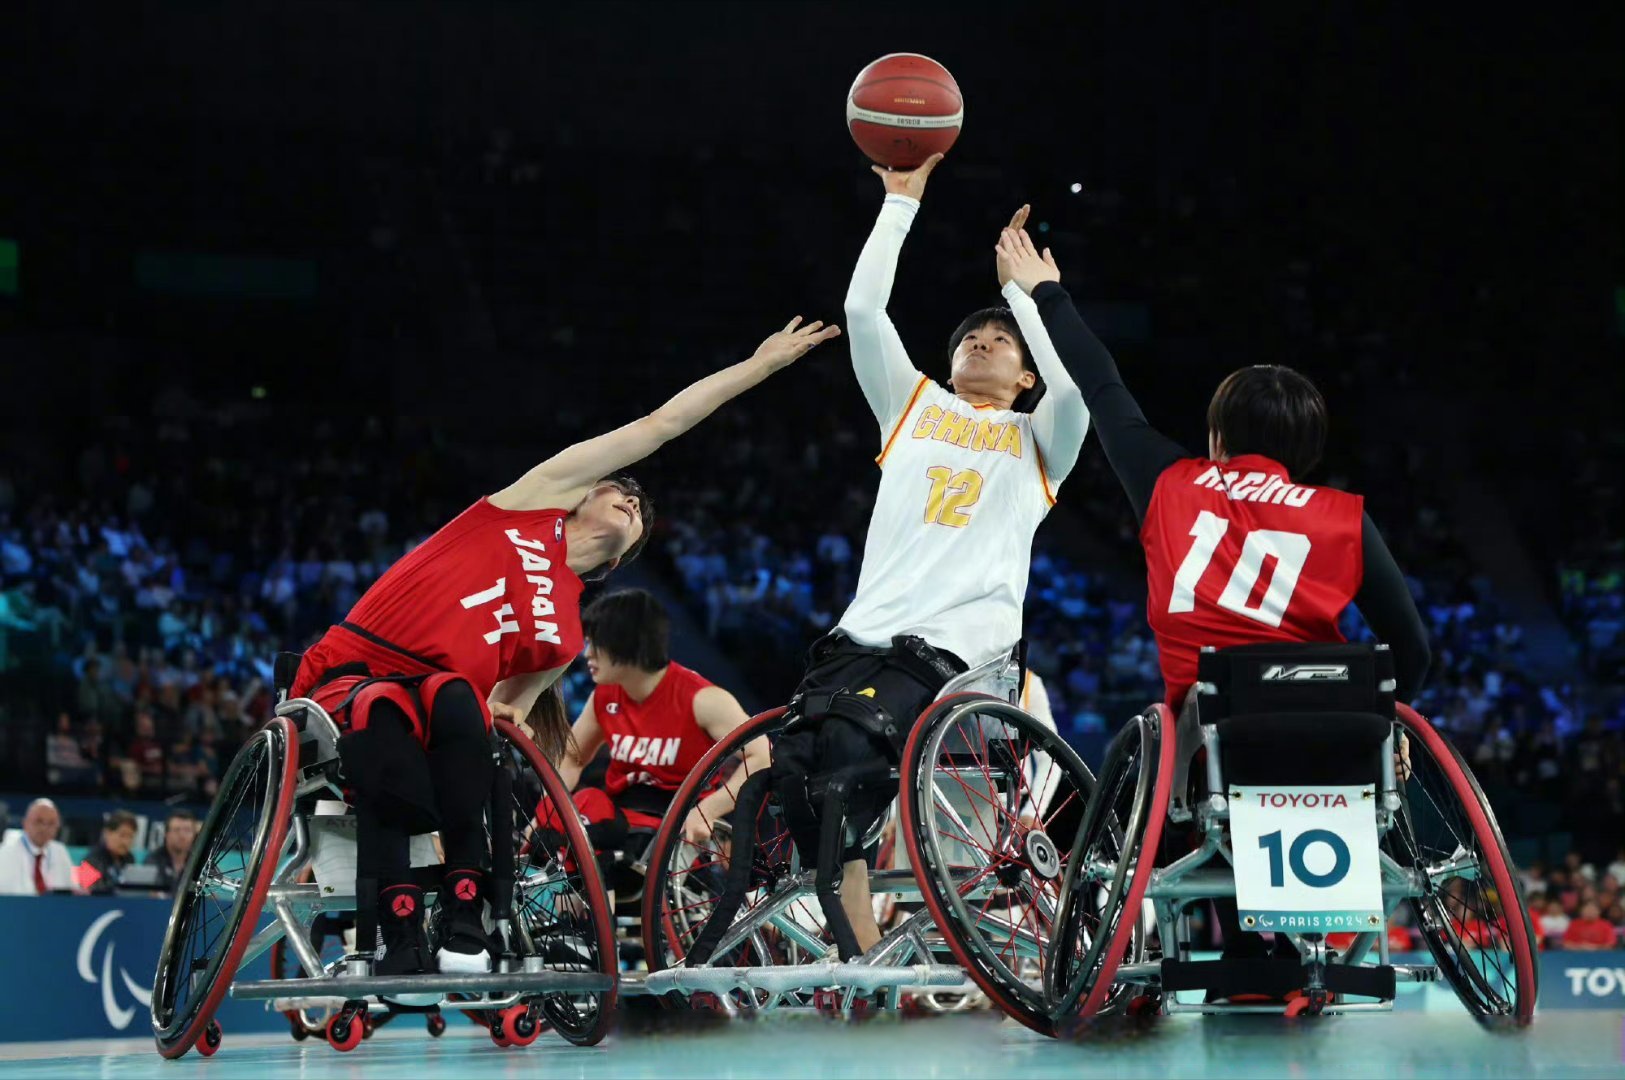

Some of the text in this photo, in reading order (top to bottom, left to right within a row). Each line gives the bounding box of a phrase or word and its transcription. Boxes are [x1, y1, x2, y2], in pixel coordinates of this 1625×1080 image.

[912, 404, 1021, 459] CHINA
[924, 466, 983, 528] 12
[504, 529, 562, 645] JAPAN
[1168, 510, 1312, 628] 10
[460, 577, 520, 645] 14
[610, 733, 681, 766] JAPAN
[1257, 793, 1348, 808] TOYOTA
[1258, 828, 1351, 888] 10
[1280, 915, 1362, 927] PARIS 2024
